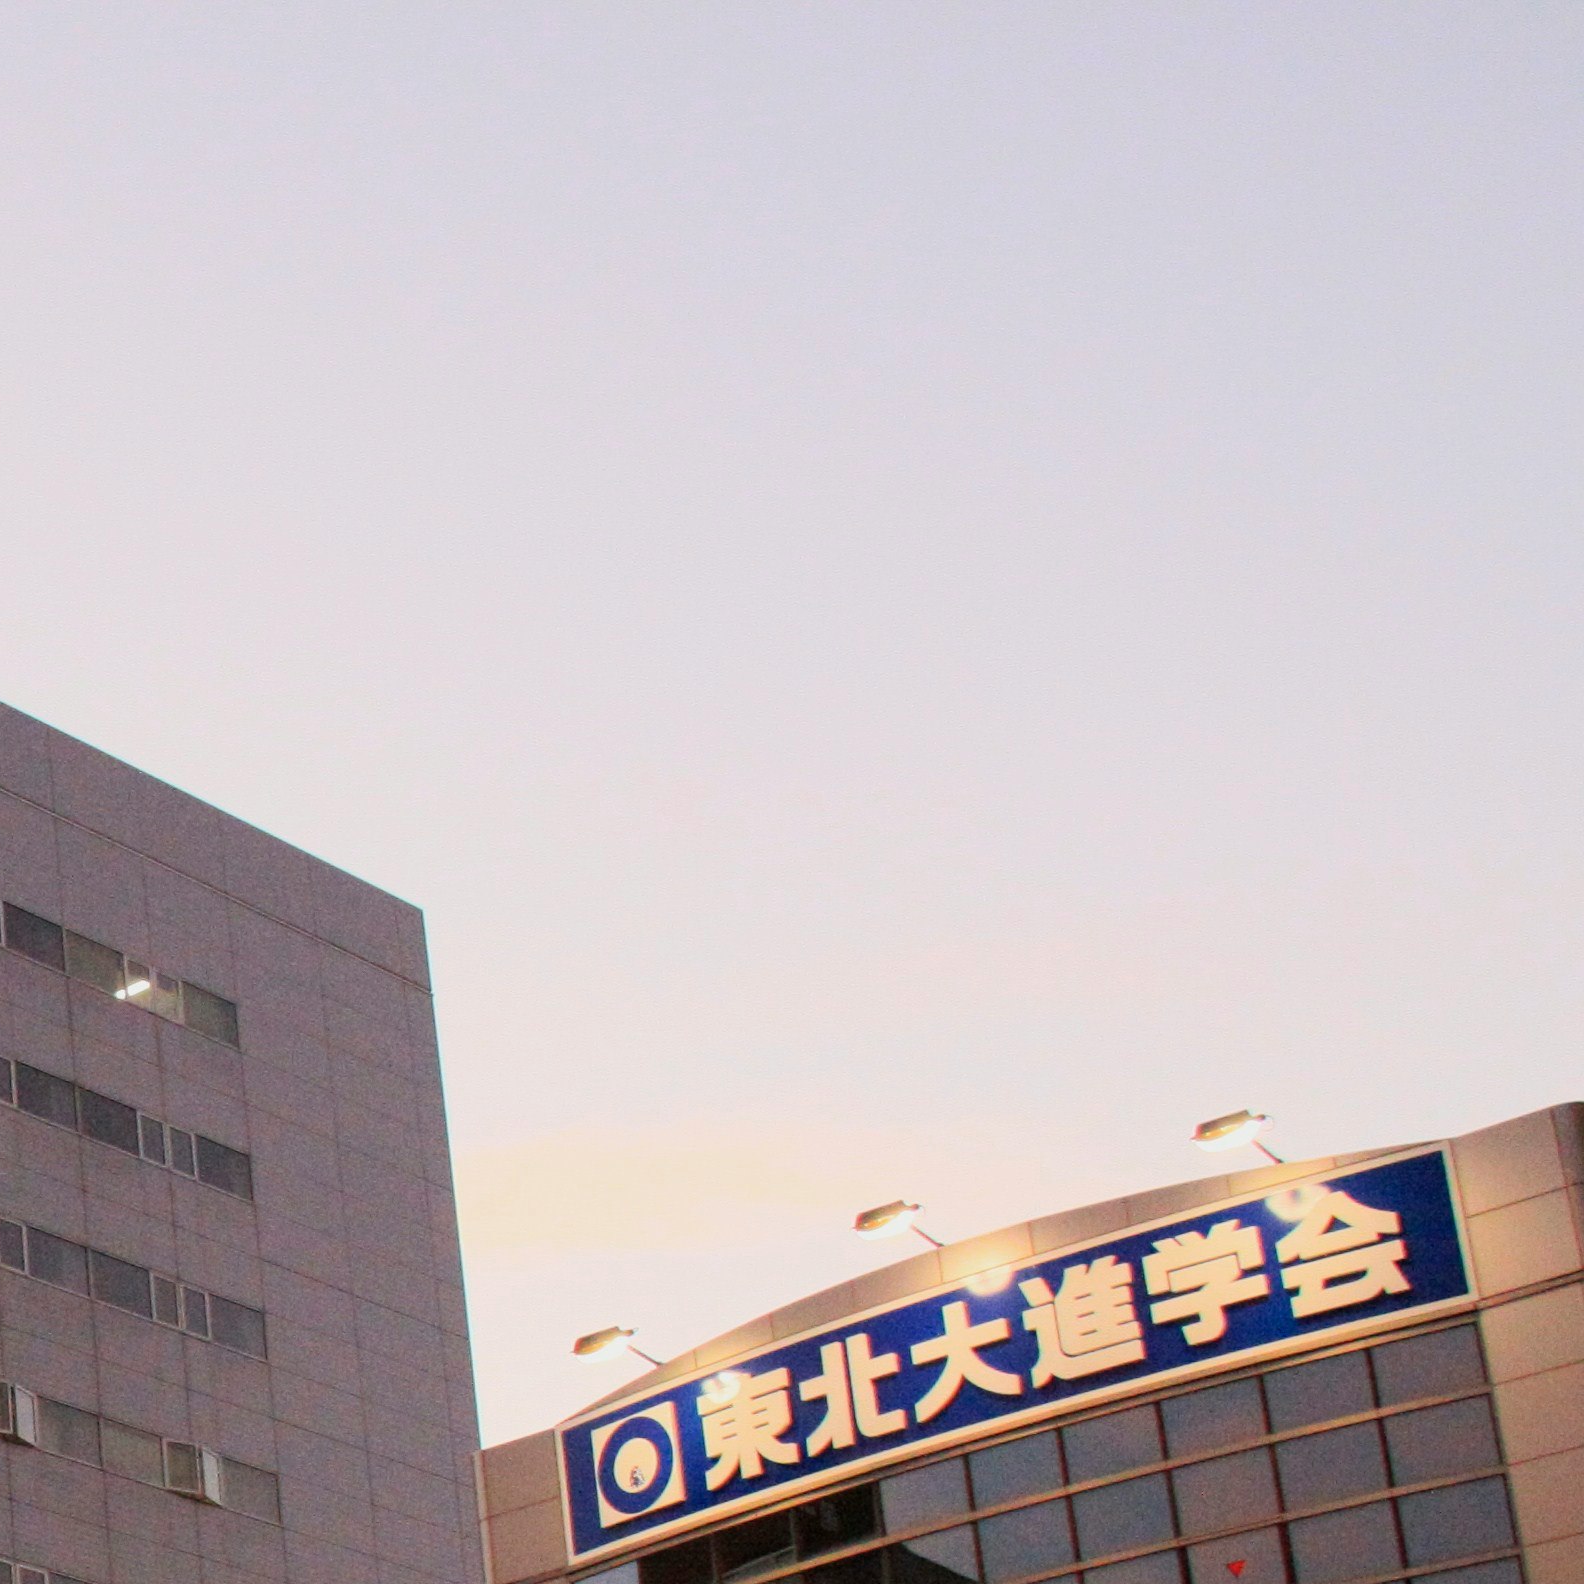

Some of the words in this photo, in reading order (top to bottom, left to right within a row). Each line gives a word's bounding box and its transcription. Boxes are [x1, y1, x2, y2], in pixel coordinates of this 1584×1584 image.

[695, 1188, 1414, 1492] 東北大進学会
